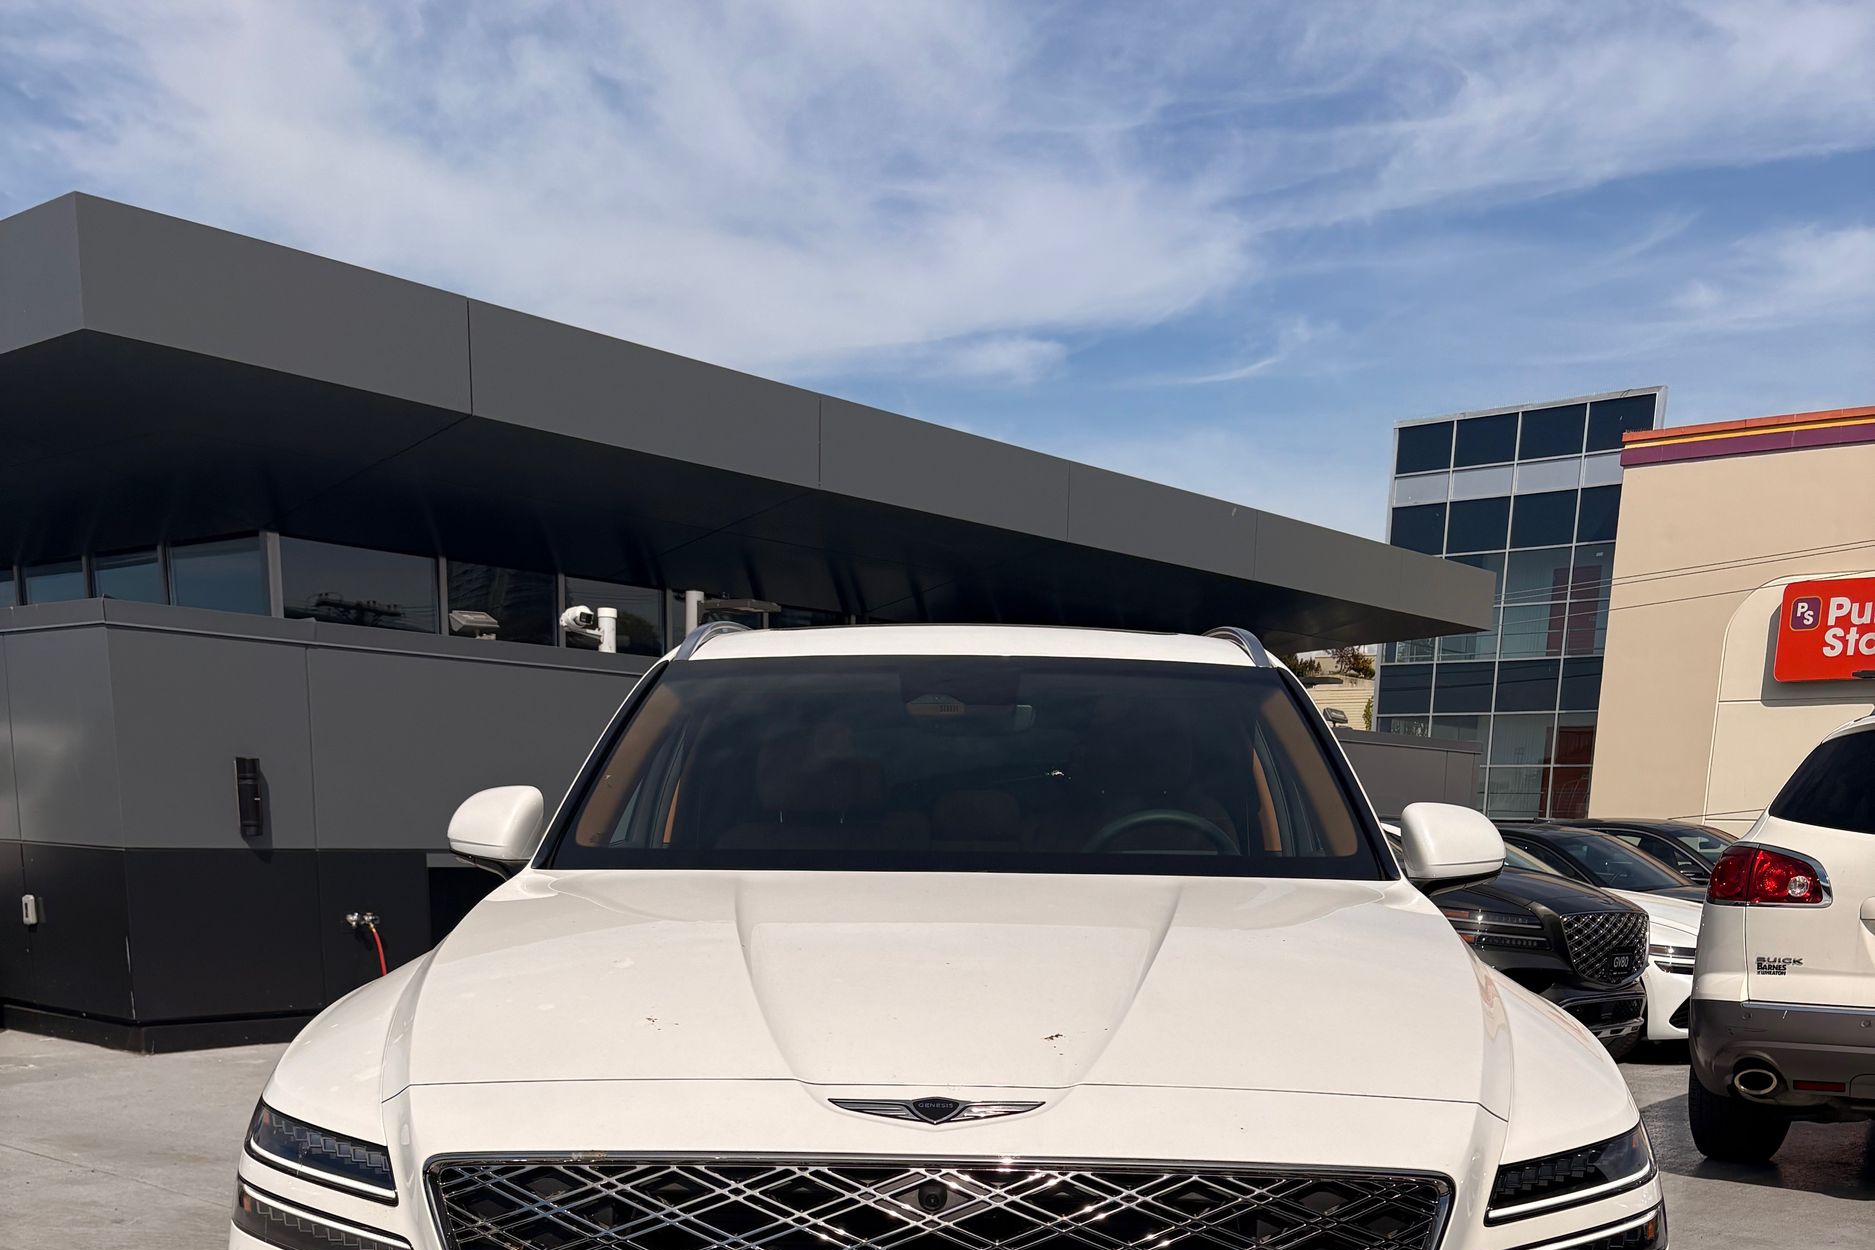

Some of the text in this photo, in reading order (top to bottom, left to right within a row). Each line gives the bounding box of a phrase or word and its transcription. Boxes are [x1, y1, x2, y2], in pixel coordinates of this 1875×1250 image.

[1827, 596, 1875, 626] Pu
[1756, 956, 1803, 965] BUICK
[1756, 962, 1787, 971] BARNES
